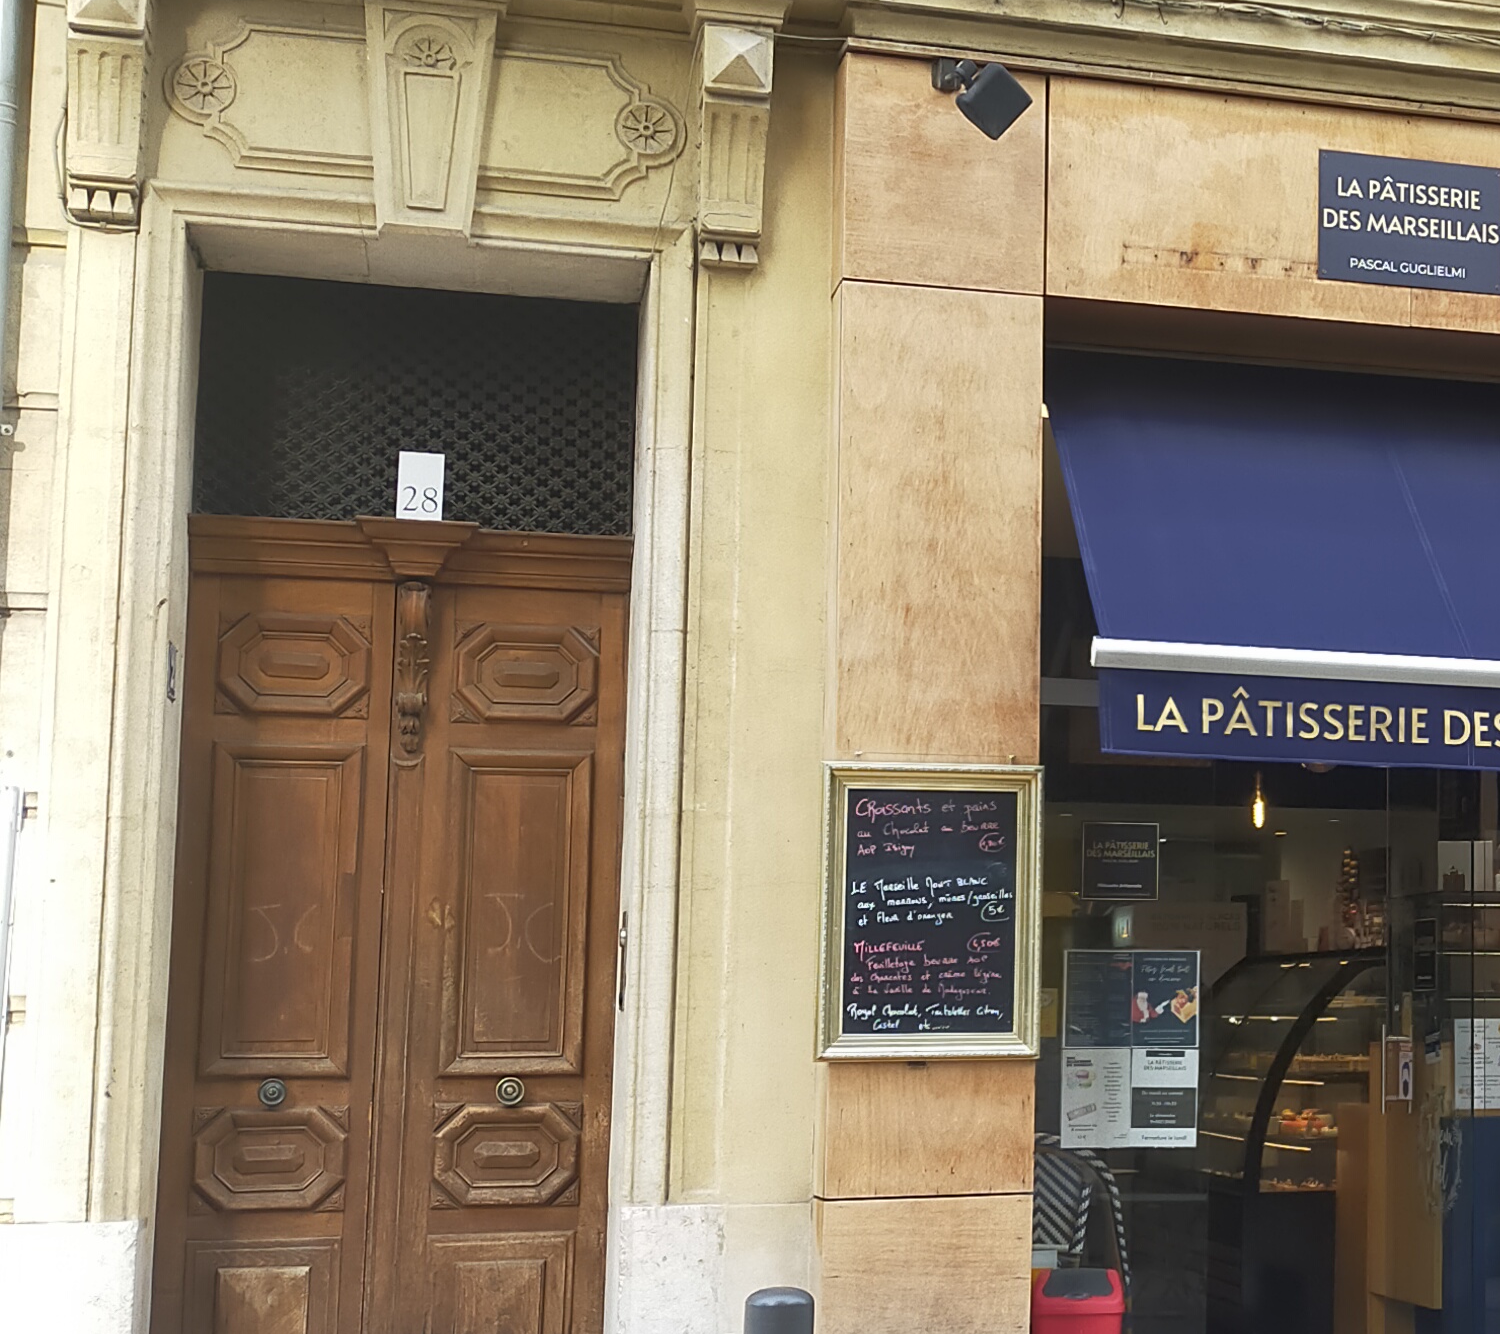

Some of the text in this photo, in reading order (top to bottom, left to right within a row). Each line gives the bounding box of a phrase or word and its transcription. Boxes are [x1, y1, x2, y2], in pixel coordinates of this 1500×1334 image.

[1337, 175, 1481, 210] LA PÂTISSERIE
[1322, 208, 1500, 244] DES MARSEILLAIS
[1350, 258, 1466, 279] PASCAL GUGLIELMI
[403, 486, 438, 513] 28
[1136, 693, 1189, 734] LA
[1202, 686, 1430, 744] PÂTISSERIE
[941, 799, 956, 813] et
[963, 801, 998, 822] pains
[883, 821, 930, 839] Chocolat
[851, 881, 867, 895] LE
[874, 877, 919, 902] Marseille
[956, 877, 989, 887] BLANC
[858, 914, 869, 927] et
